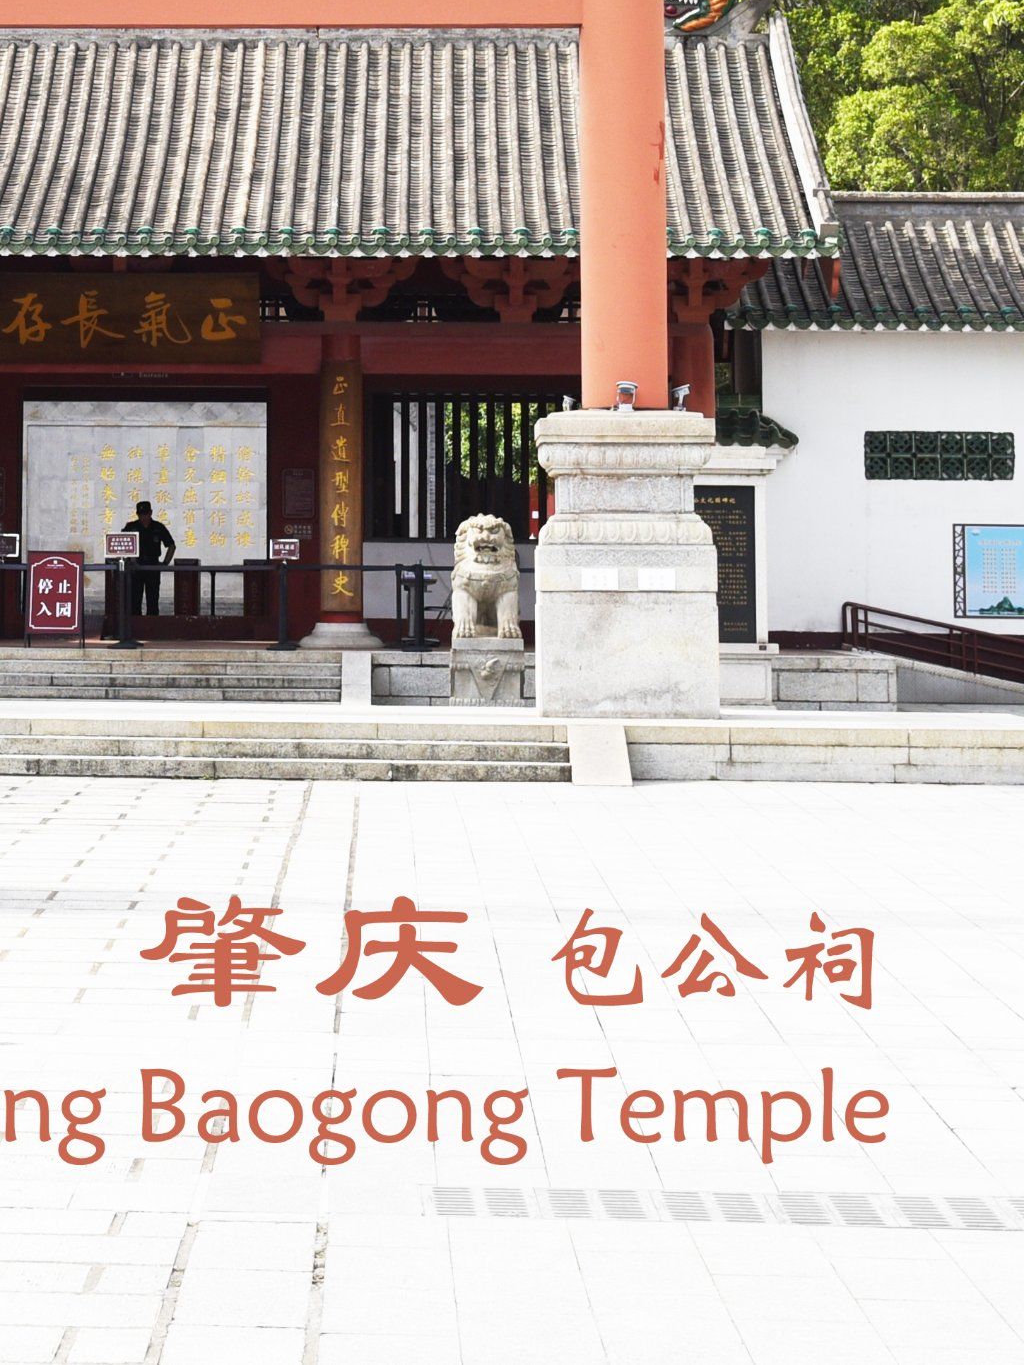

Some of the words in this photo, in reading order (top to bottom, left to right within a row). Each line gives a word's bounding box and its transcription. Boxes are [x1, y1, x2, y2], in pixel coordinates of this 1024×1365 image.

[2, 290, 247, 348] 正氣長存
[38, 578, 72, 595] 停止
[36, 601, 72, 618] 入园
